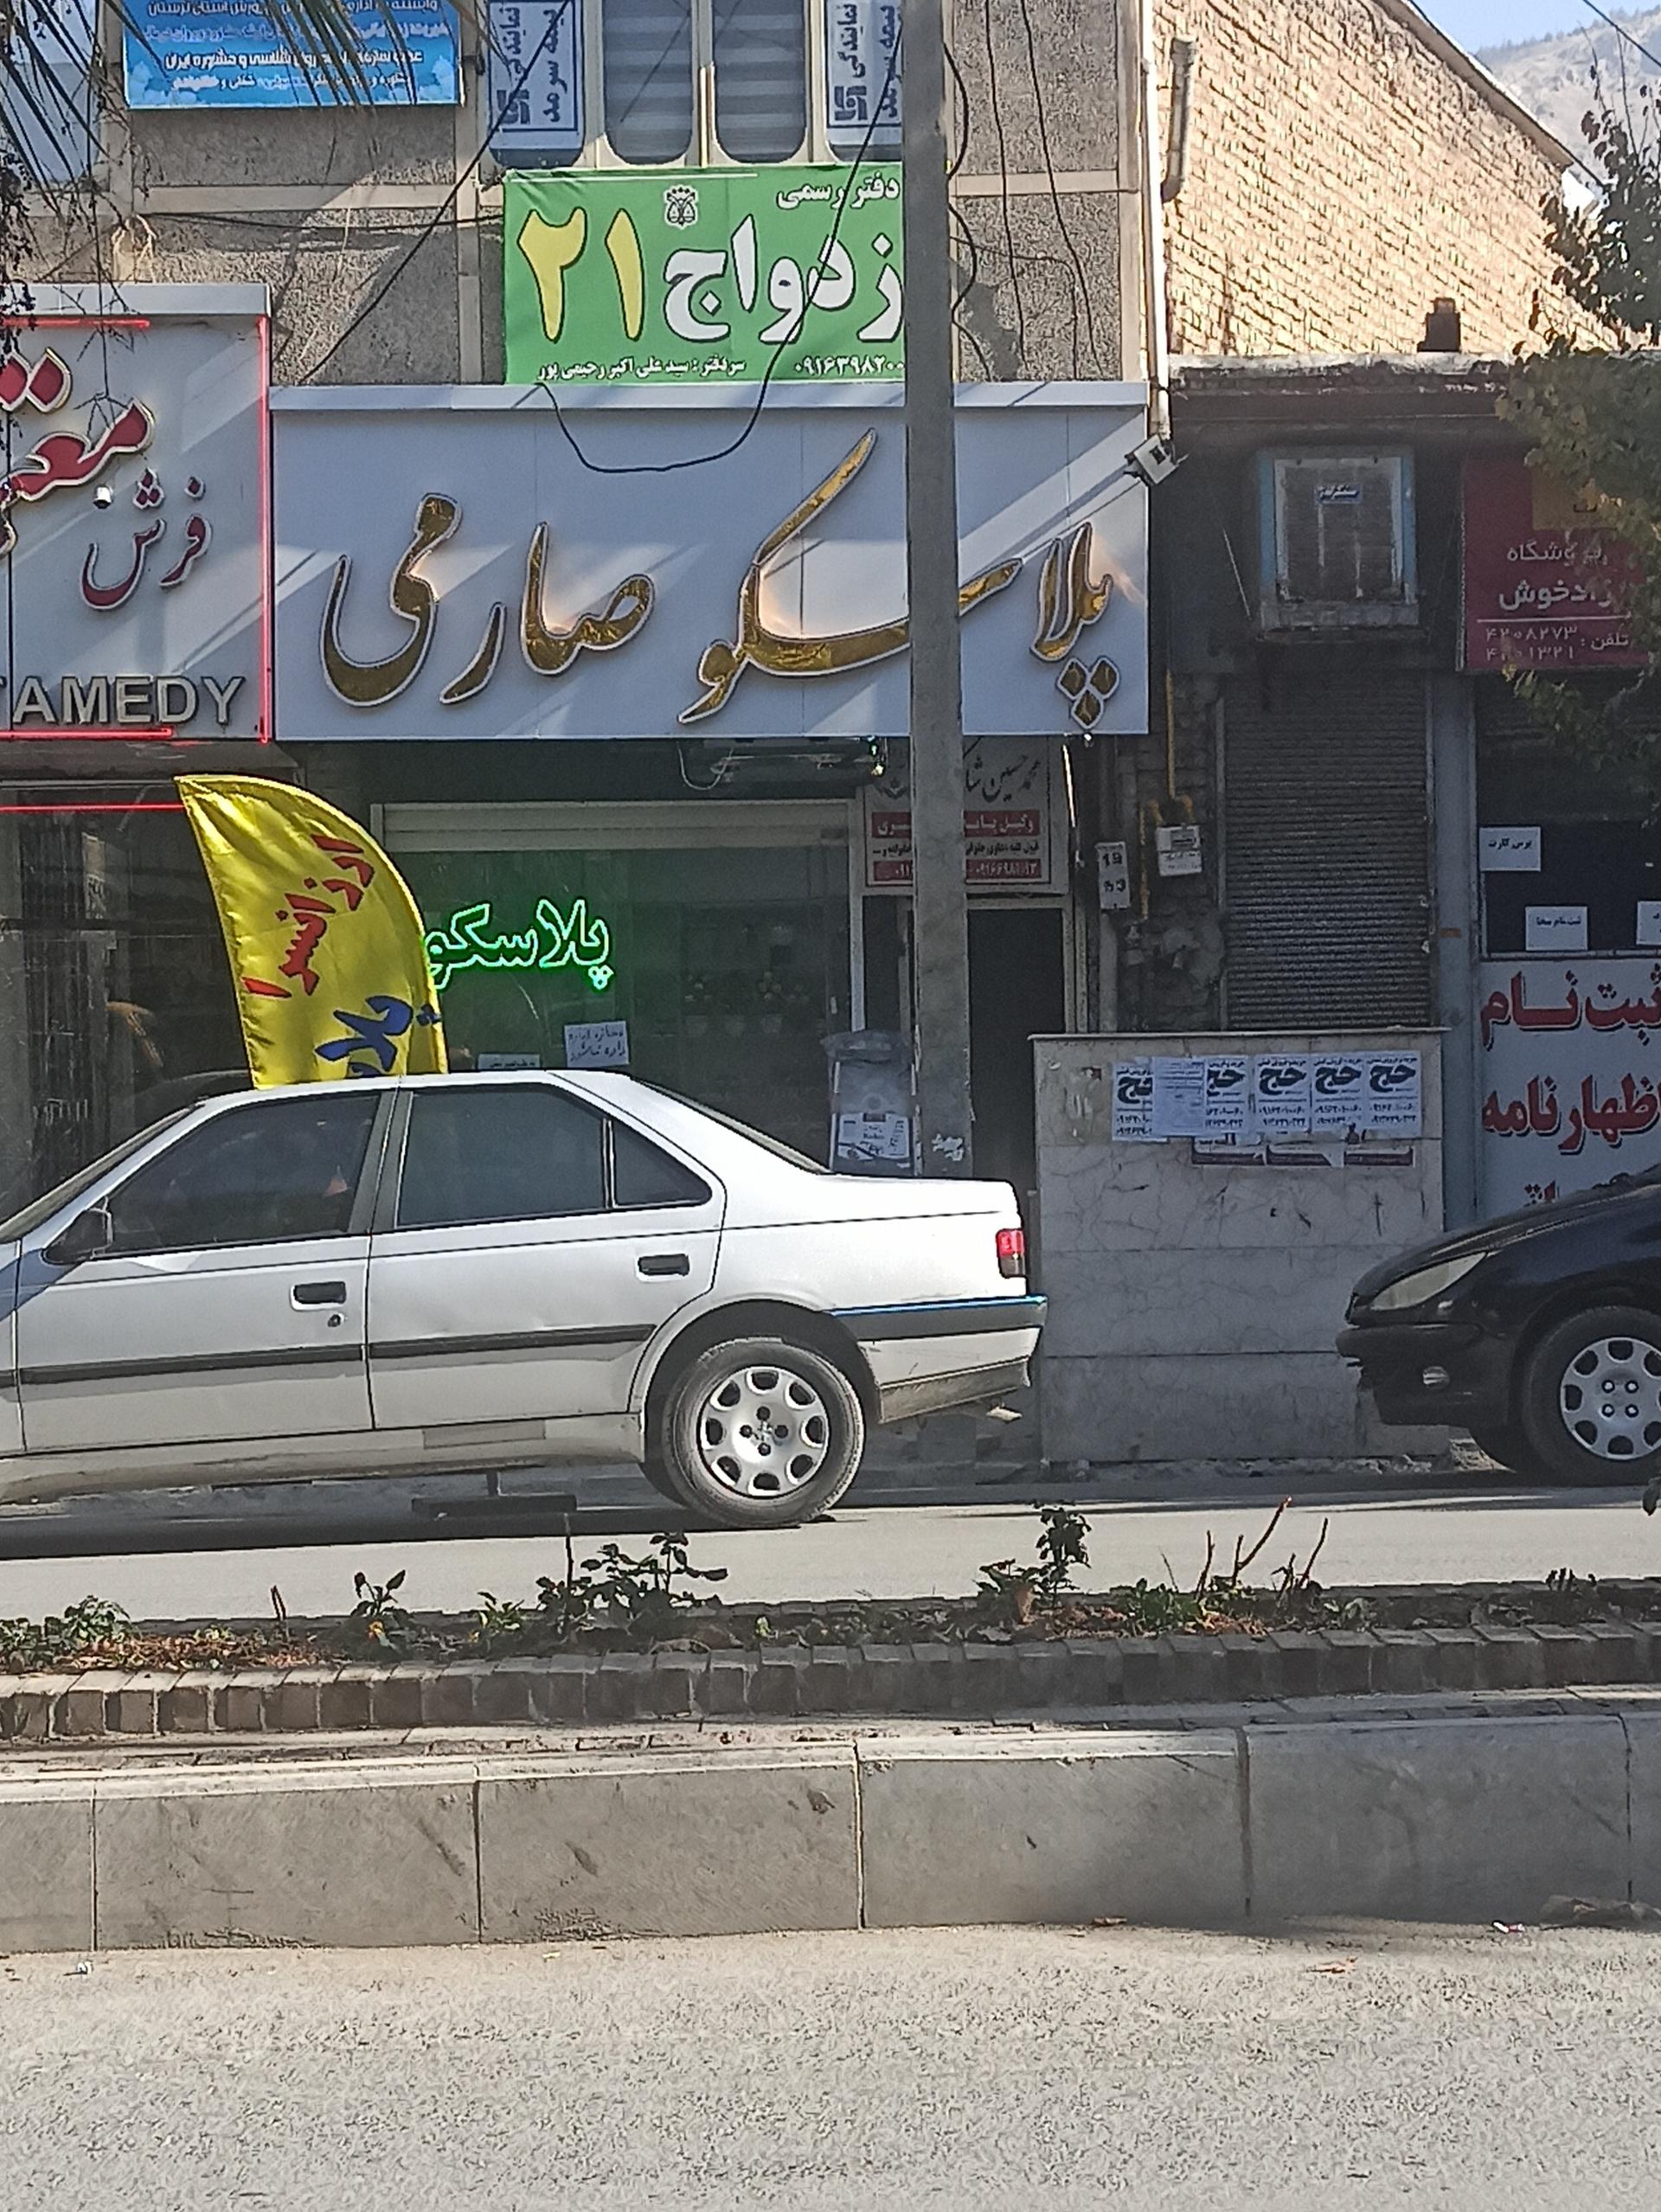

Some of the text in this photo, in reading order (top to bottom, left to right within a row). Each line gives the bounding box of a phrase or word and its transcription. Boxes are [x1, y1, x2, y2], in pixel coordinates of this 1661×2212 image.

[836, 3, 866, 79] نمایندگی
[775, 170, 901, 210] دفتر رسمی
[662, 213, 904, 344] زدواج
[608, 356, 635, 379] اکبر
[664, 357, 690, 378] سید
[80, 469, 212, 611] فرش
[0, 675, 246, 727] AMEDY
[423, 898, 615, 991] پلاسکو
[1480, 963, 1661, 1051] ثبت نام
[1259, 1067, 1307, 1096] حج
[1315, 1066, 1363, 1094] حج
[1369, 1064, 1416, 1093] حج
